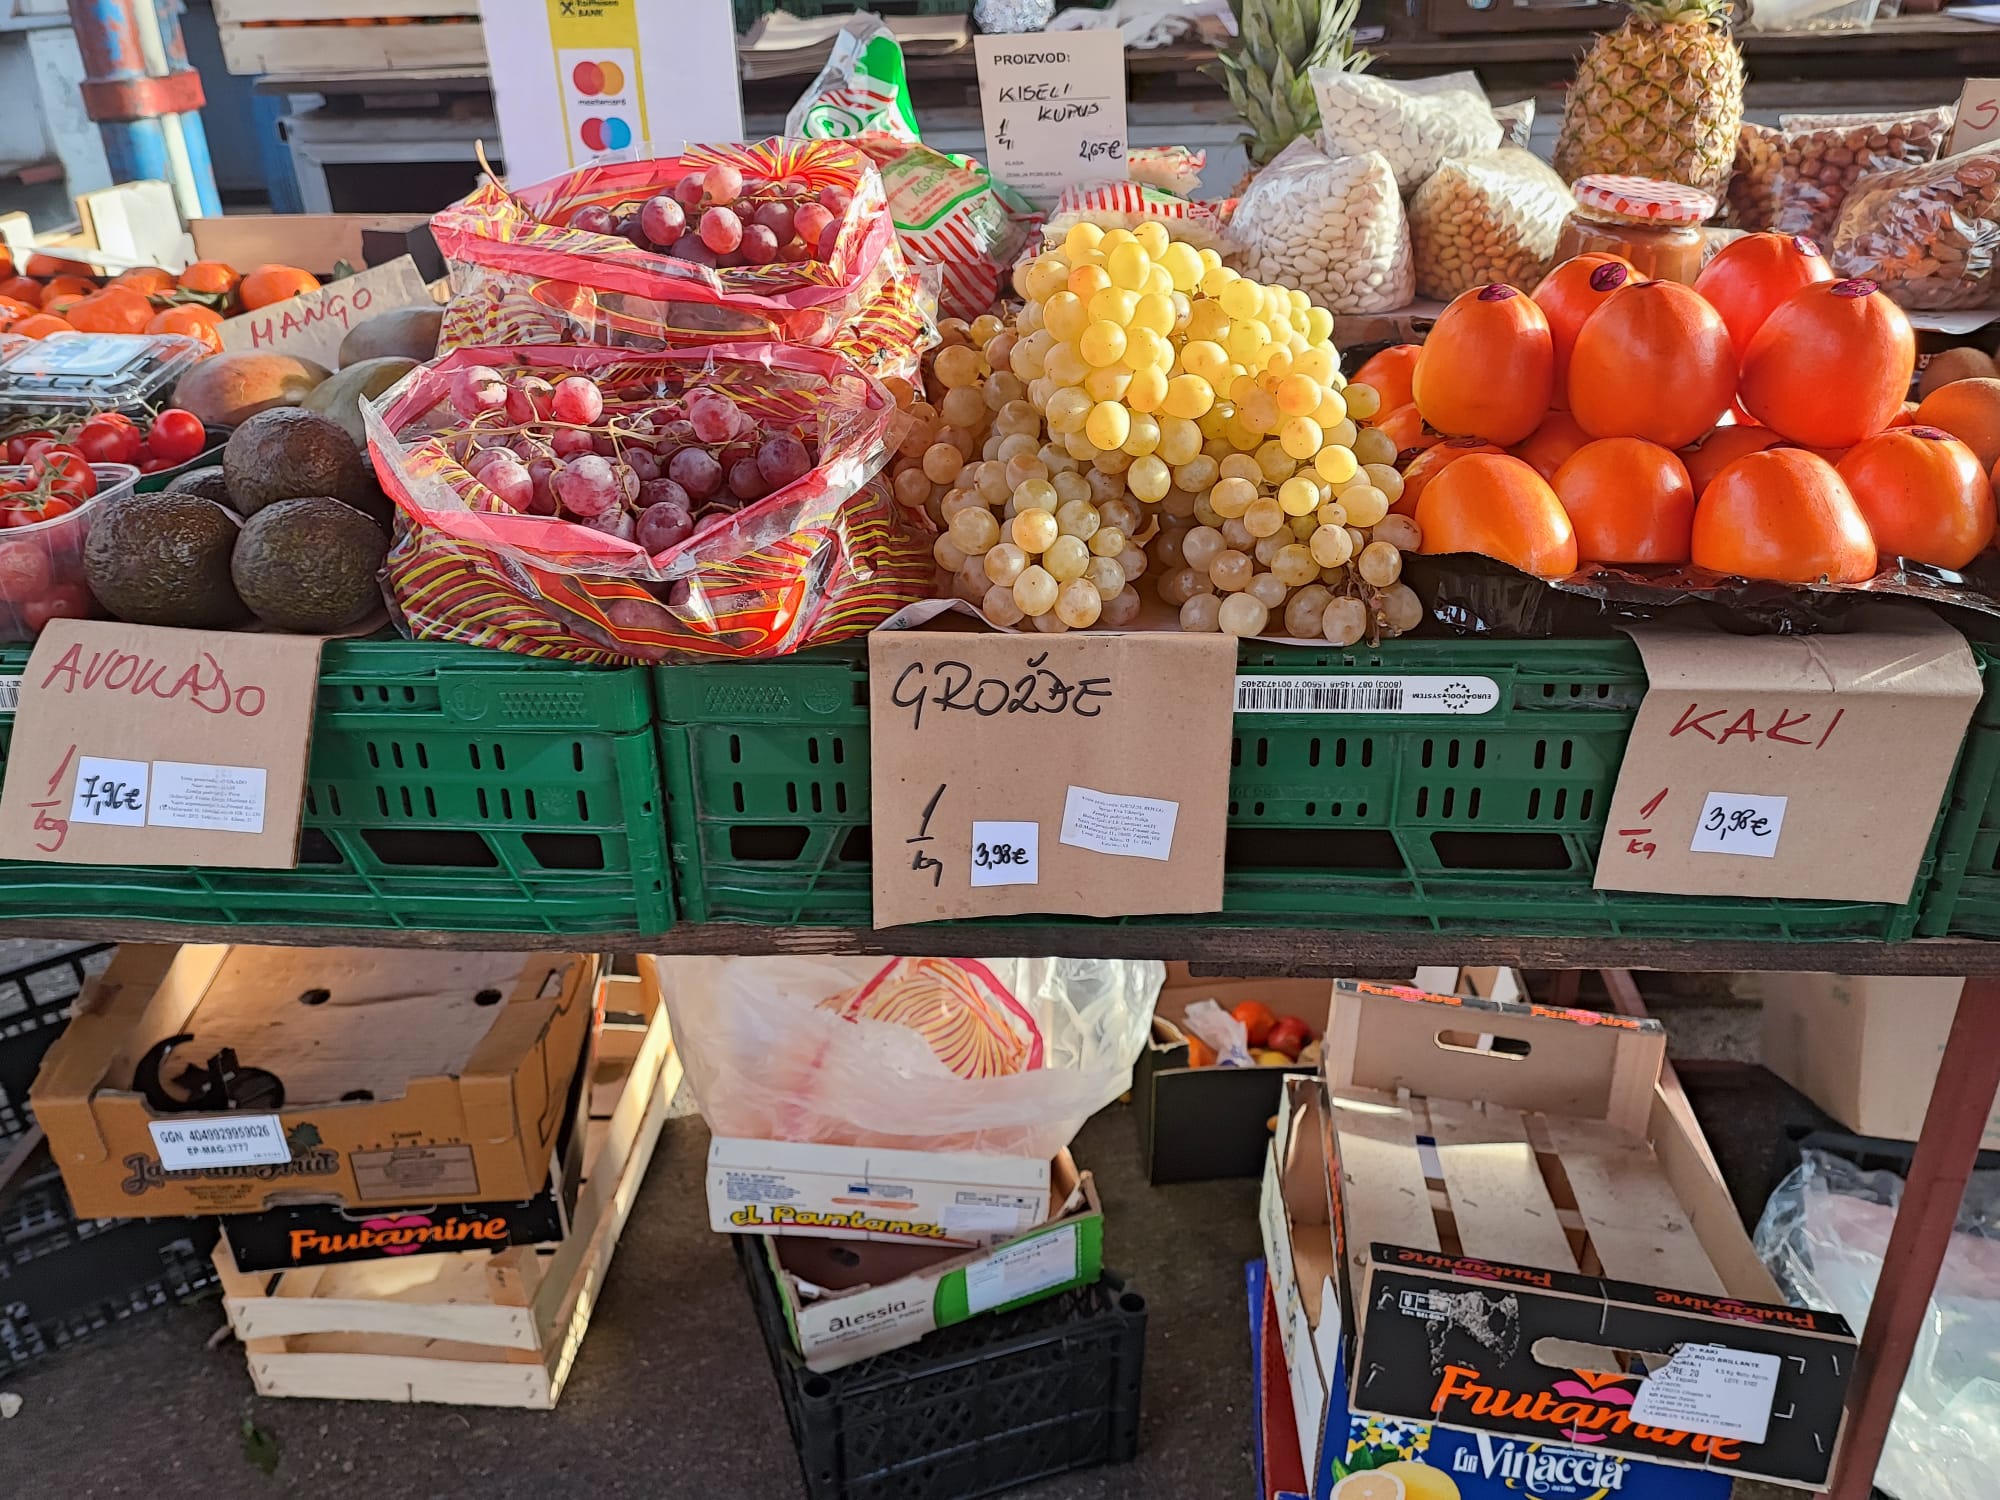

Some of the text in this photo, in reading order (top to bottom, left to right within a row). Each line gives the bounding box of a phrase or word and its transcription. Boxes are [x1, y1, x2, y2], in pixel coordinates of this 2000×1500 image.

[993, 52, 1071, 66] PROIZVOD:
[998, 82, 1071, 102] KISELI
[1037, 102, 1099, 123] KUPUS
[1078, 140, 1123, 162] 2,65€
[250, 287, 372, 348] MANGO
[1412, 692, 1443, 700] SYSTEM
[1470, 692, 1492, 700] EURO
[1668, 703, 1845, 750] KAKI
[1705, 806, 1772, 841] 3,98€
[974, 842, 1029, 870] 3,98€
[160, 1130, 184, 1144] GGN
[730, 1205, 763, 1226] el
[289, 1216, 509, 1261] Frutamine
[1399, 1249, 1552, 1288] Frutamine
[829, 1300, 907, 1333] alessia
[1654, 1290, 1818, 1330] Frutamine
[1475, 1431, 1624, 1494] Vinaccia
